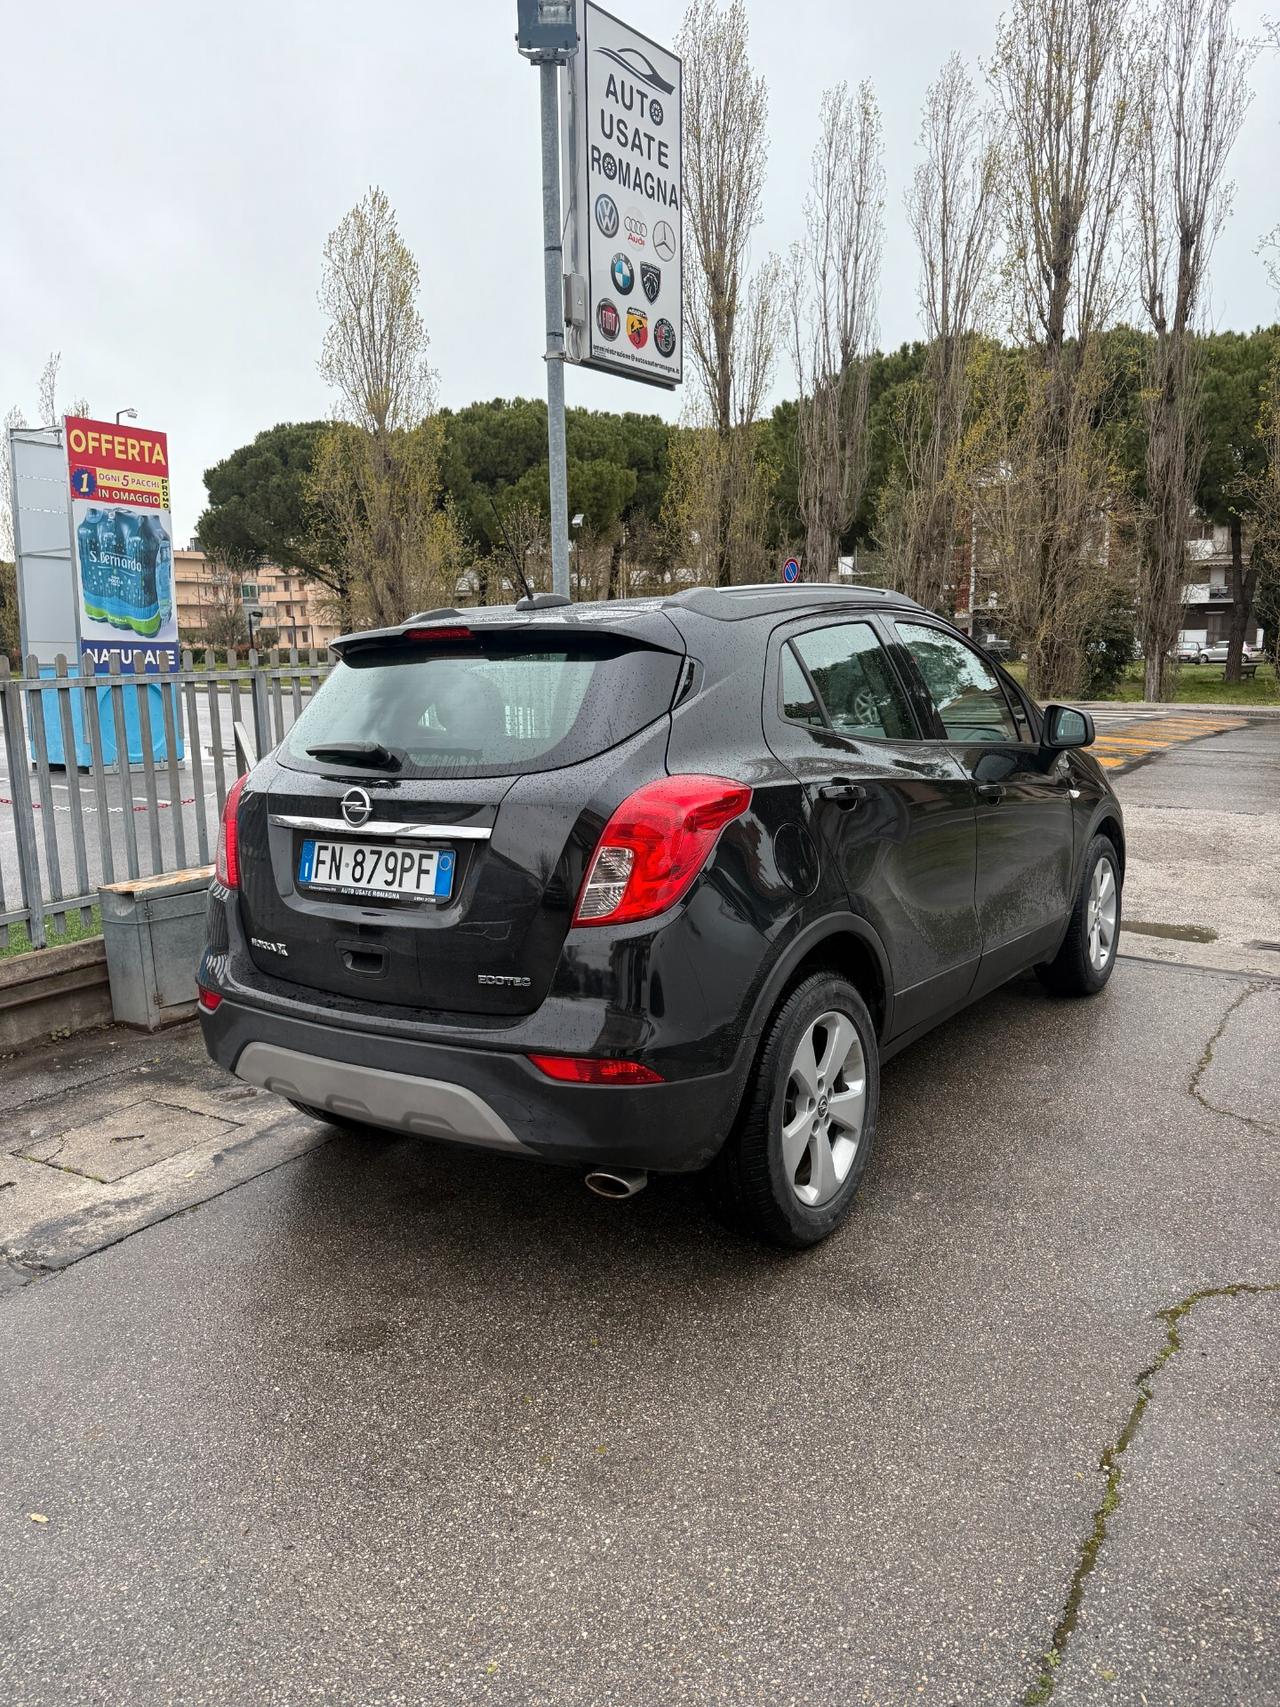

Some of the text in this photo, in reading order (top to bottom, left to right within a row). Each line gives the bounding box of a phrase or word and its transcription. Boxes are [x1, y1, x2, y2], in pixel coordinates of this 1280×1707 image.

[605, 73, 664, 126] AUTO
[600, 108, 669, 170] USATE
[591, 144, 679, 211] ROMAGNA
[602, 310, 616, 331] FIAT
[69, 429, 166, 466] OFFERTA
[80, 472, 89, 492] 1
[98, 473, 160, 489] OGNI 5 PACCHI
[98, 489, 160, 505] IN OMAGGIO
[161, 479, 169, 509] PROMO
[373, 890, 400, 899] ROMAGNA
[478, 974, 531, 987] ECOTEC
